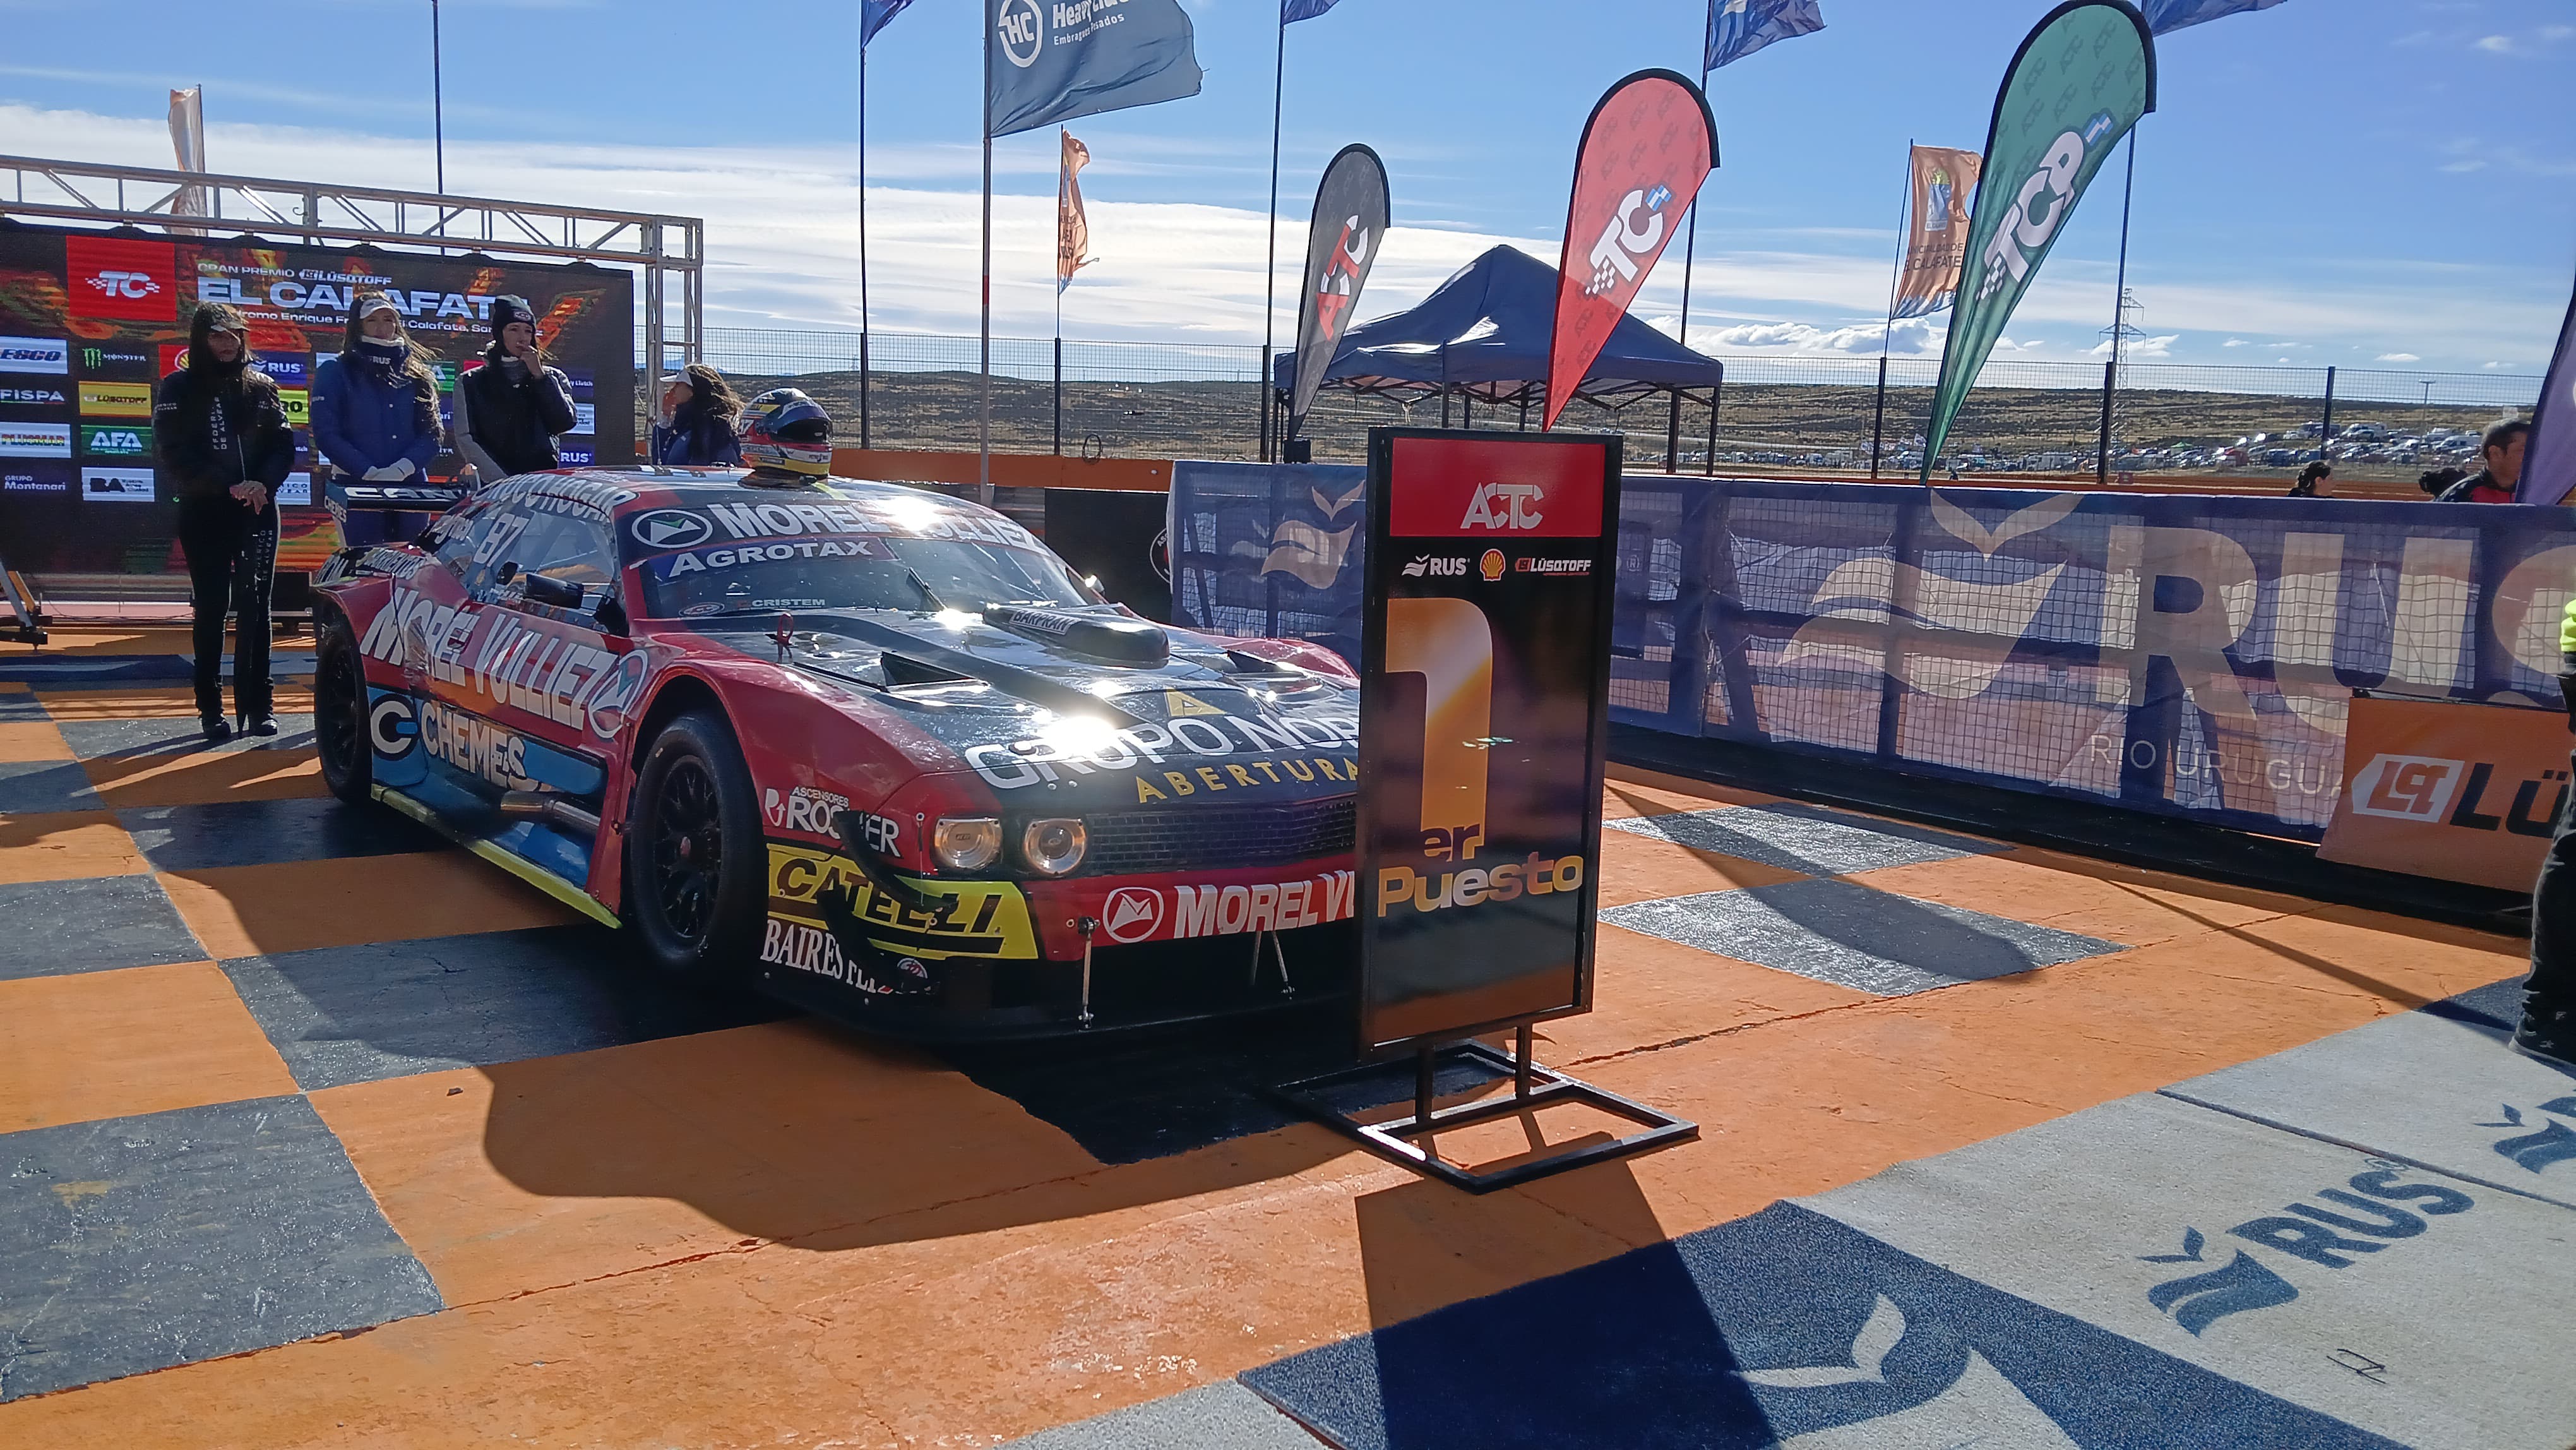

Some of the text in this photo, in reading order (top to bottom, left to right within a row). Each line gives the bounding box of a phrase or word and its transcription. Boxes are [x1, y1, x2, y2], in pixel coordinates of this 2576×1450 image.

[1590, 189, 1663, 282] TC
[1951, 243, 1964, 252] DE
[198, 263, 238, 274] GRAN
[242, 267, 295, 278] PREMIO
[1316, 214, 1369, 342] ACTC
[1913, 255, 1962, 270] CALAFATE
[99, 271, 152, 299] TC
[198, 277, 263, 306] EL
[281, 313, 333, 324] Enrique
[0, 349, 61, 362] ESCO
[102, 353, 146, 362] MONSTER
[268, 362, 301, 373] RUS
[373, 356, 392, 365] RUS
[1, 389, 64, 402] FISPA
[91, 431, 143, 448] AFA
[561, 452, 589, 463] RUS
[4, 482, 66, 491] Montanari
[707, 503, 890, 539] MOREL
[1460, 482, 1544, 529] ACTC
[474, 513, 530, 568] 87
[669, 540, 874, 577] AGROTAX
[1429, 558, 1467, 576] RUS
[360, 587, 480, 687] MOREL
[421, 702, 526, 783] CHEMES
[1385, 597, 1493, 859] 1
[2090, 734, 2157, 770] RIO
[792, 786, 849, 808] ASCENSORES
[2449, 762, 2570, 839] LÜ
[786, 795, 901, 858] ROSER
[1421, 824, 1480, 861] er
[1378, 851, 1584, 918] Puesto
[1173, 880, 1318, 939] MOREL
[760, 919, 844, 980] BAIRES
[2225, 1169, 2475, 1270] RUS
